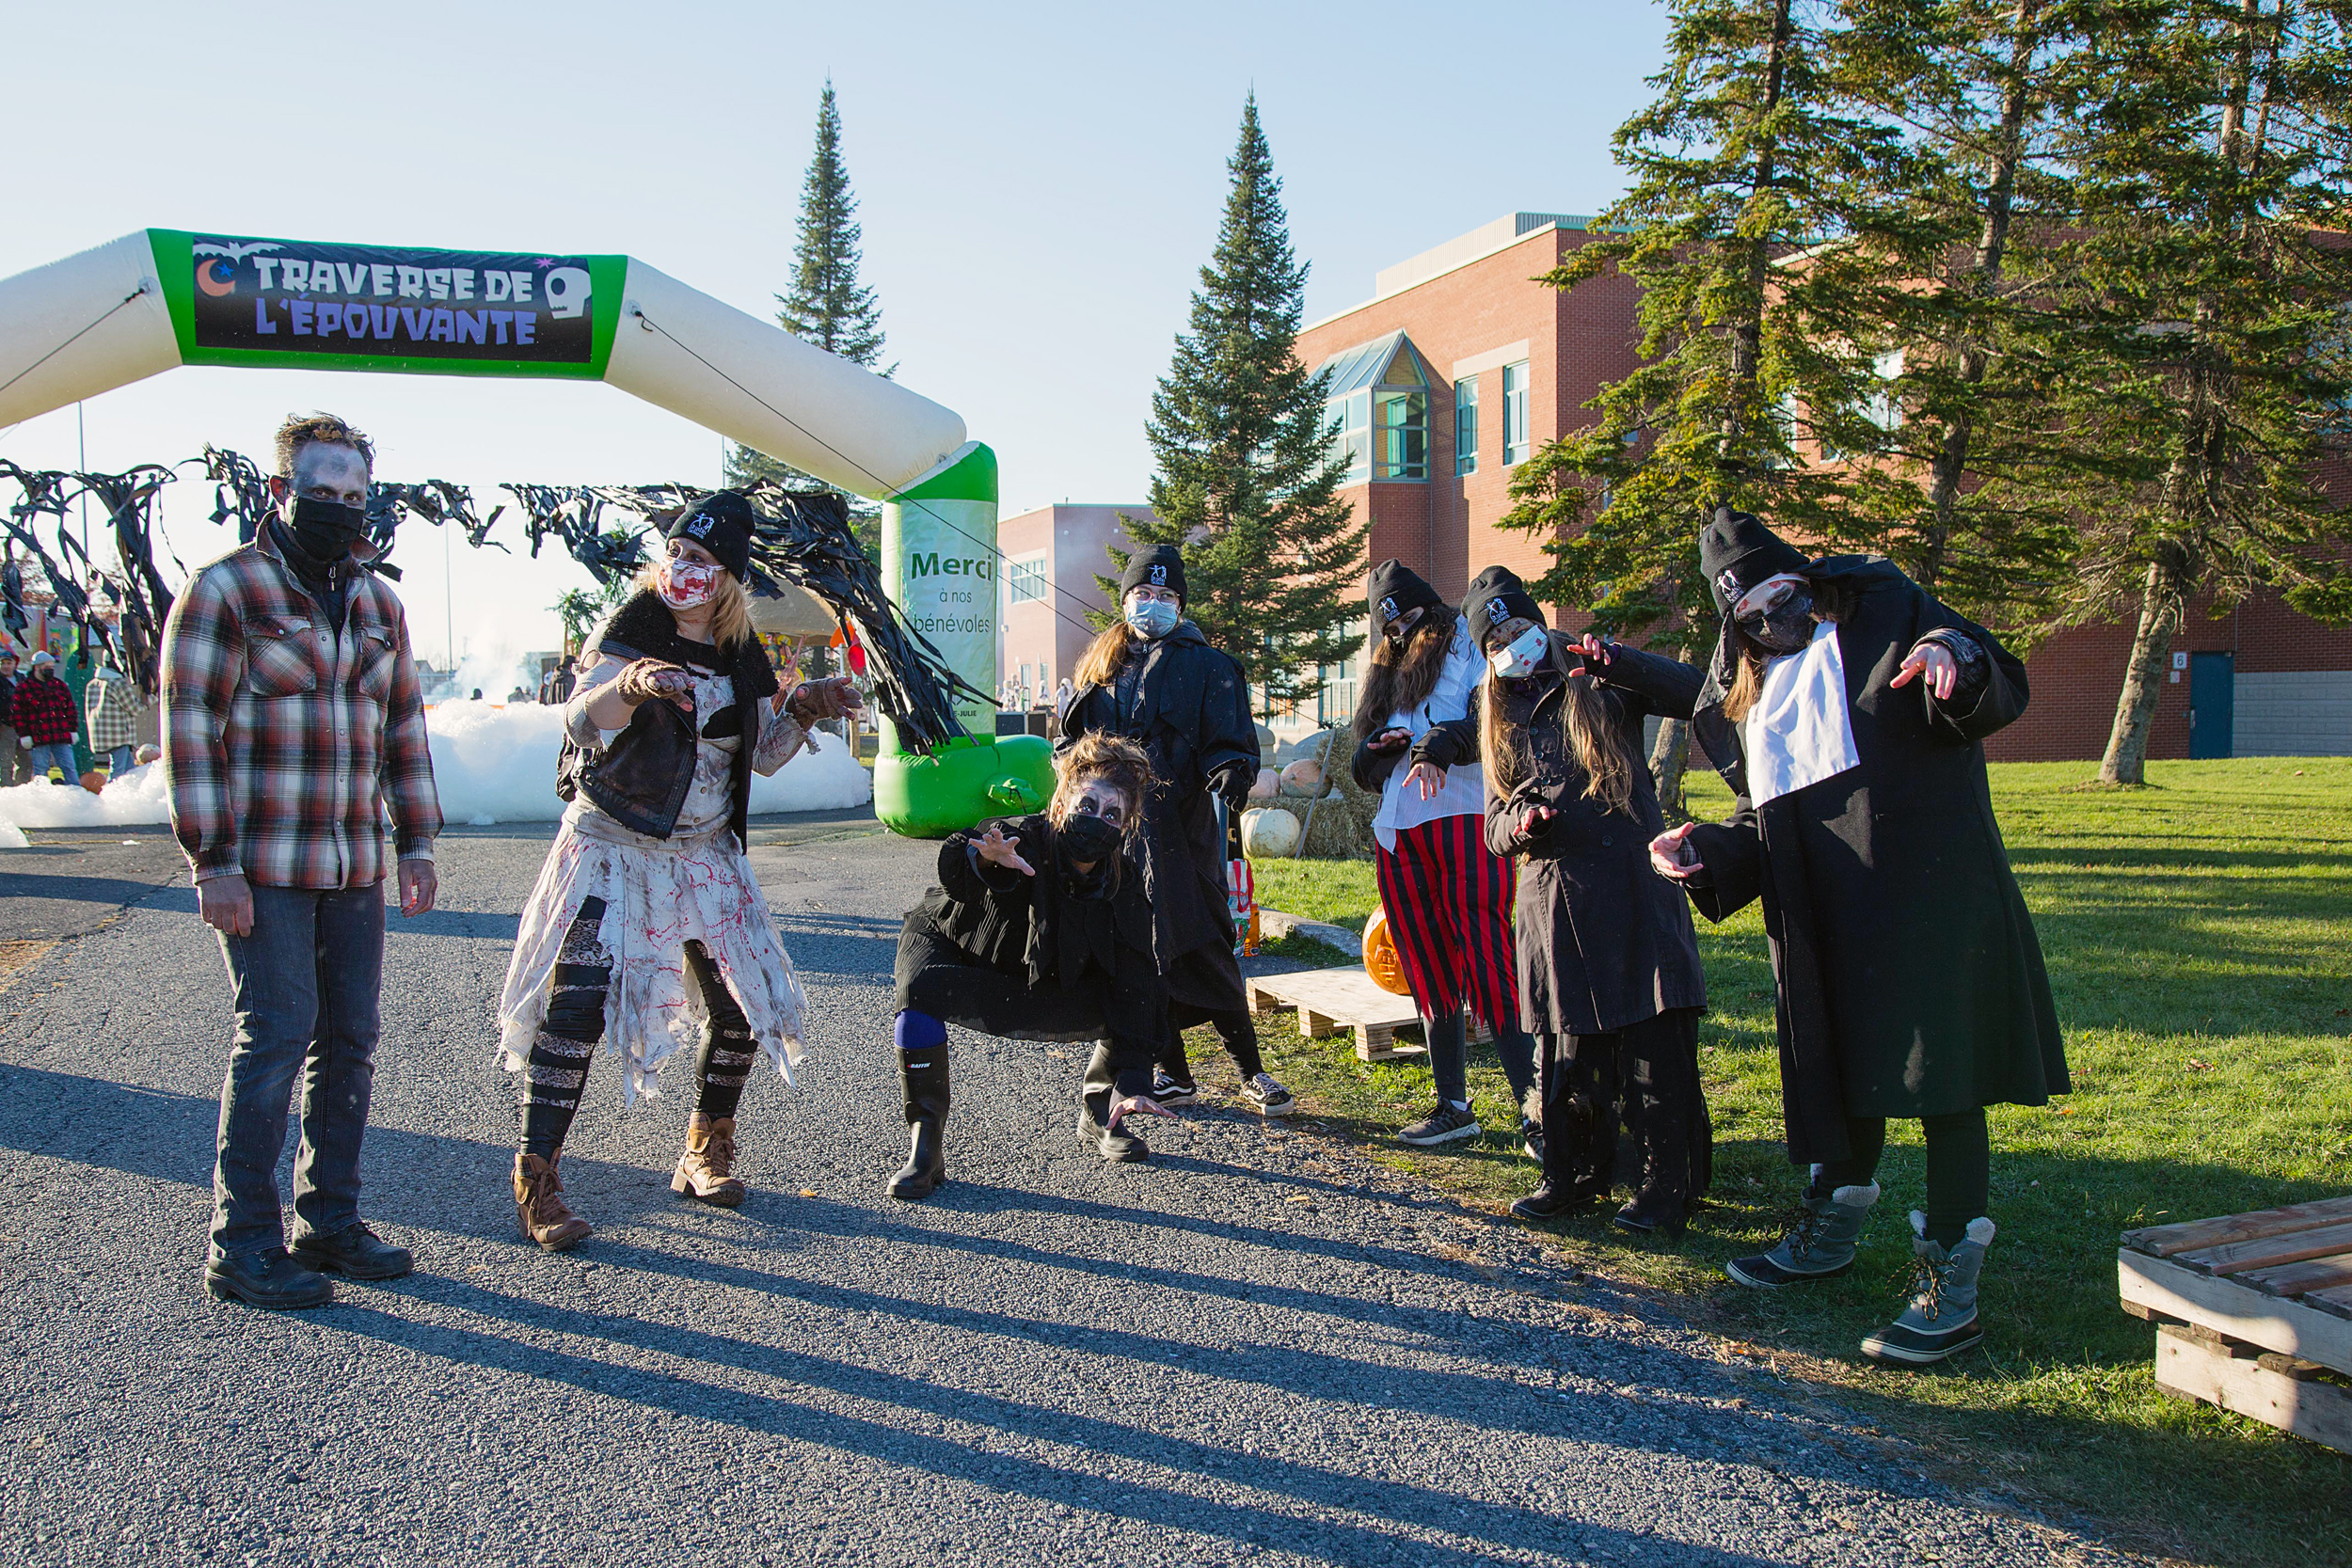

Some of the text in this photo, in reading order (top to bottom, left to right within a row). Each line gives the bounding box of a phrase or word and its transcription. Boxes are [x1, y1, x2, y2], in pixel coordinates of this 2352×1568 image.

[252, 256, 532, 303] TRAVERSE DE
[255, 293, 537, 345] L'ÉPOUVANTE
[911, 552, 992, 581] Merci
[939, 587, 972, 603] à nos
[914, 612, 990, 633] bénévoles
[2177, 655, 2184, 666] 6
